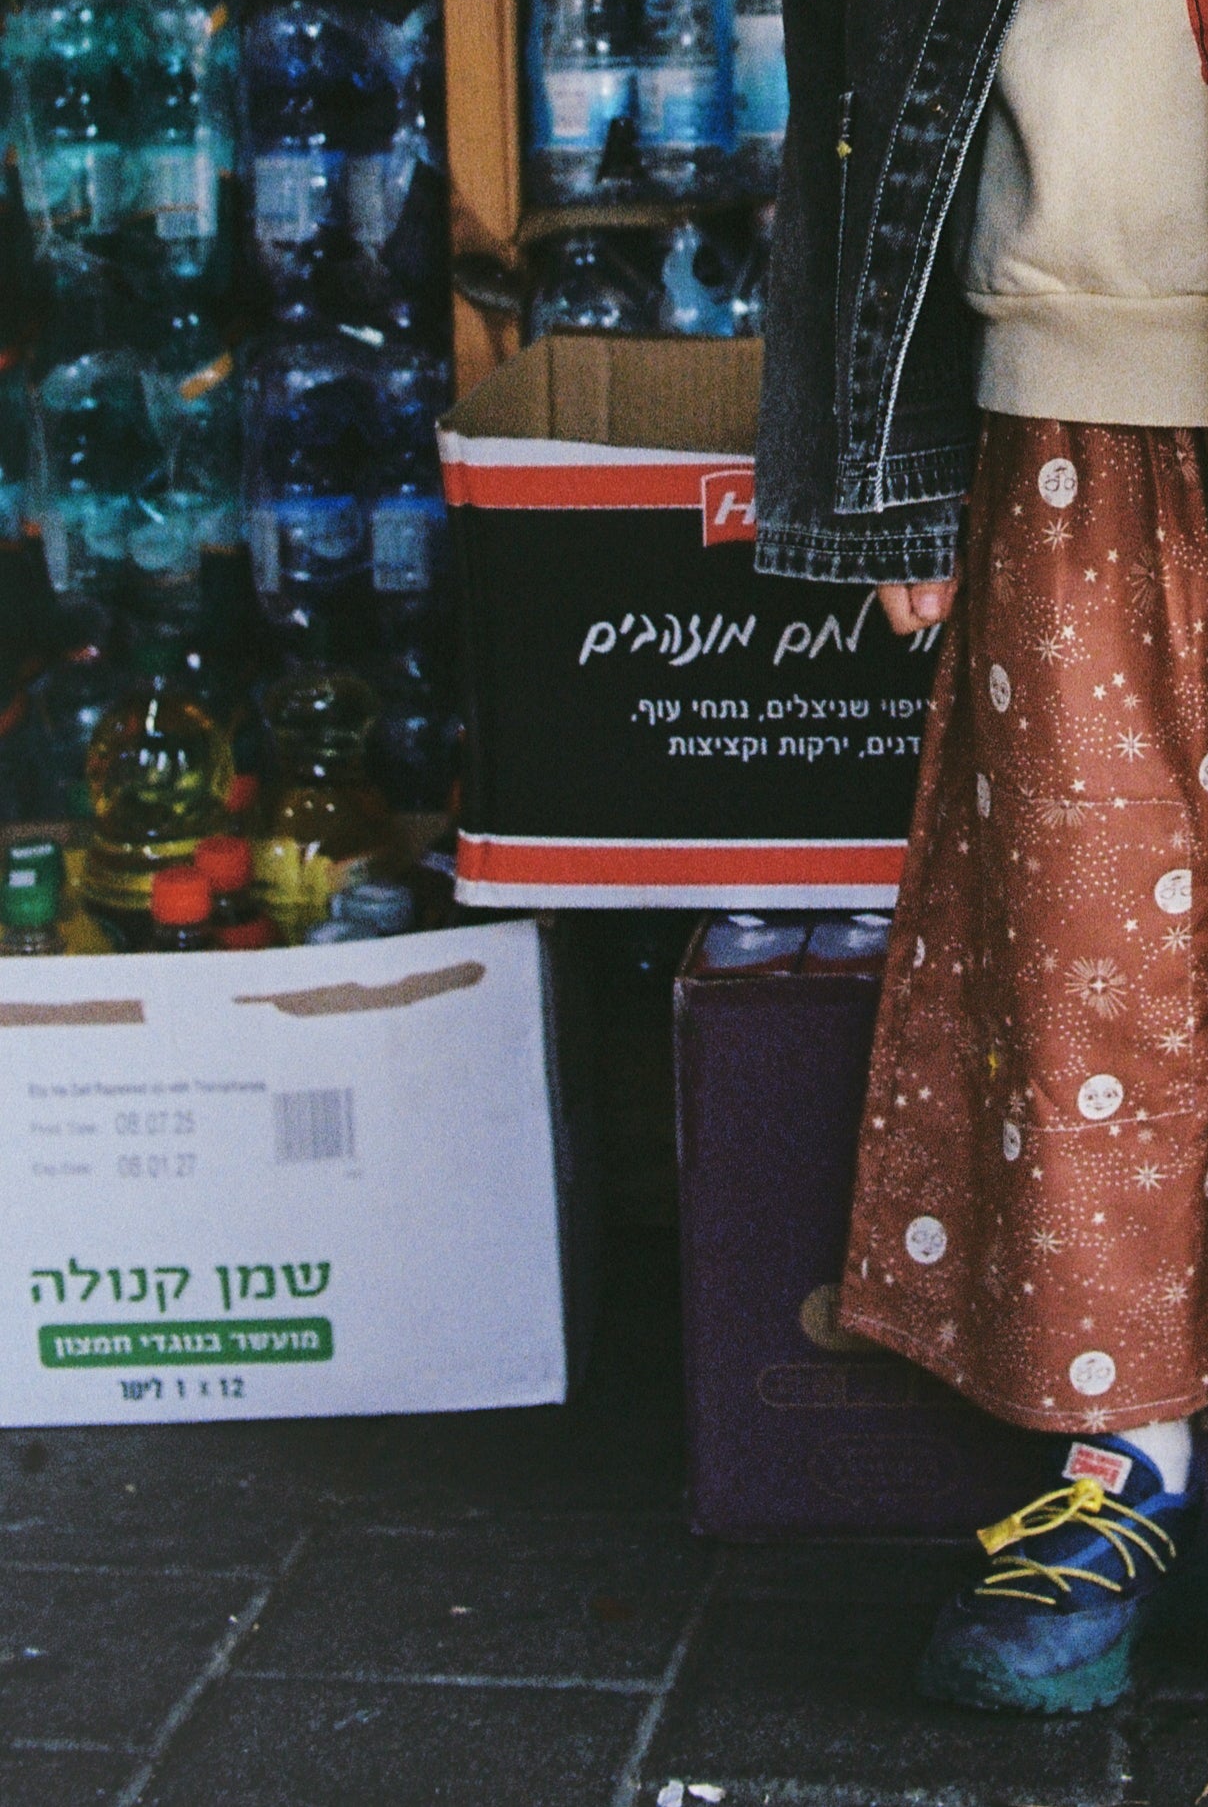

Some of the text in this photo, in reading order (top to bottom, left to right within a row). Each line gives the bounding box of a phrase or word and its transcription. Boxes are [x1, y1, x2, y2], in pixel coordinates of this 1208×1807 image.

[692, 699, 750, 719] נתחי
[778, 735, 850, 763] ירקות
[31, 1256, 332, 1313] שמן קנולה
[53, 1328, 321, 1361] מועשר בנוגדי חמצון
